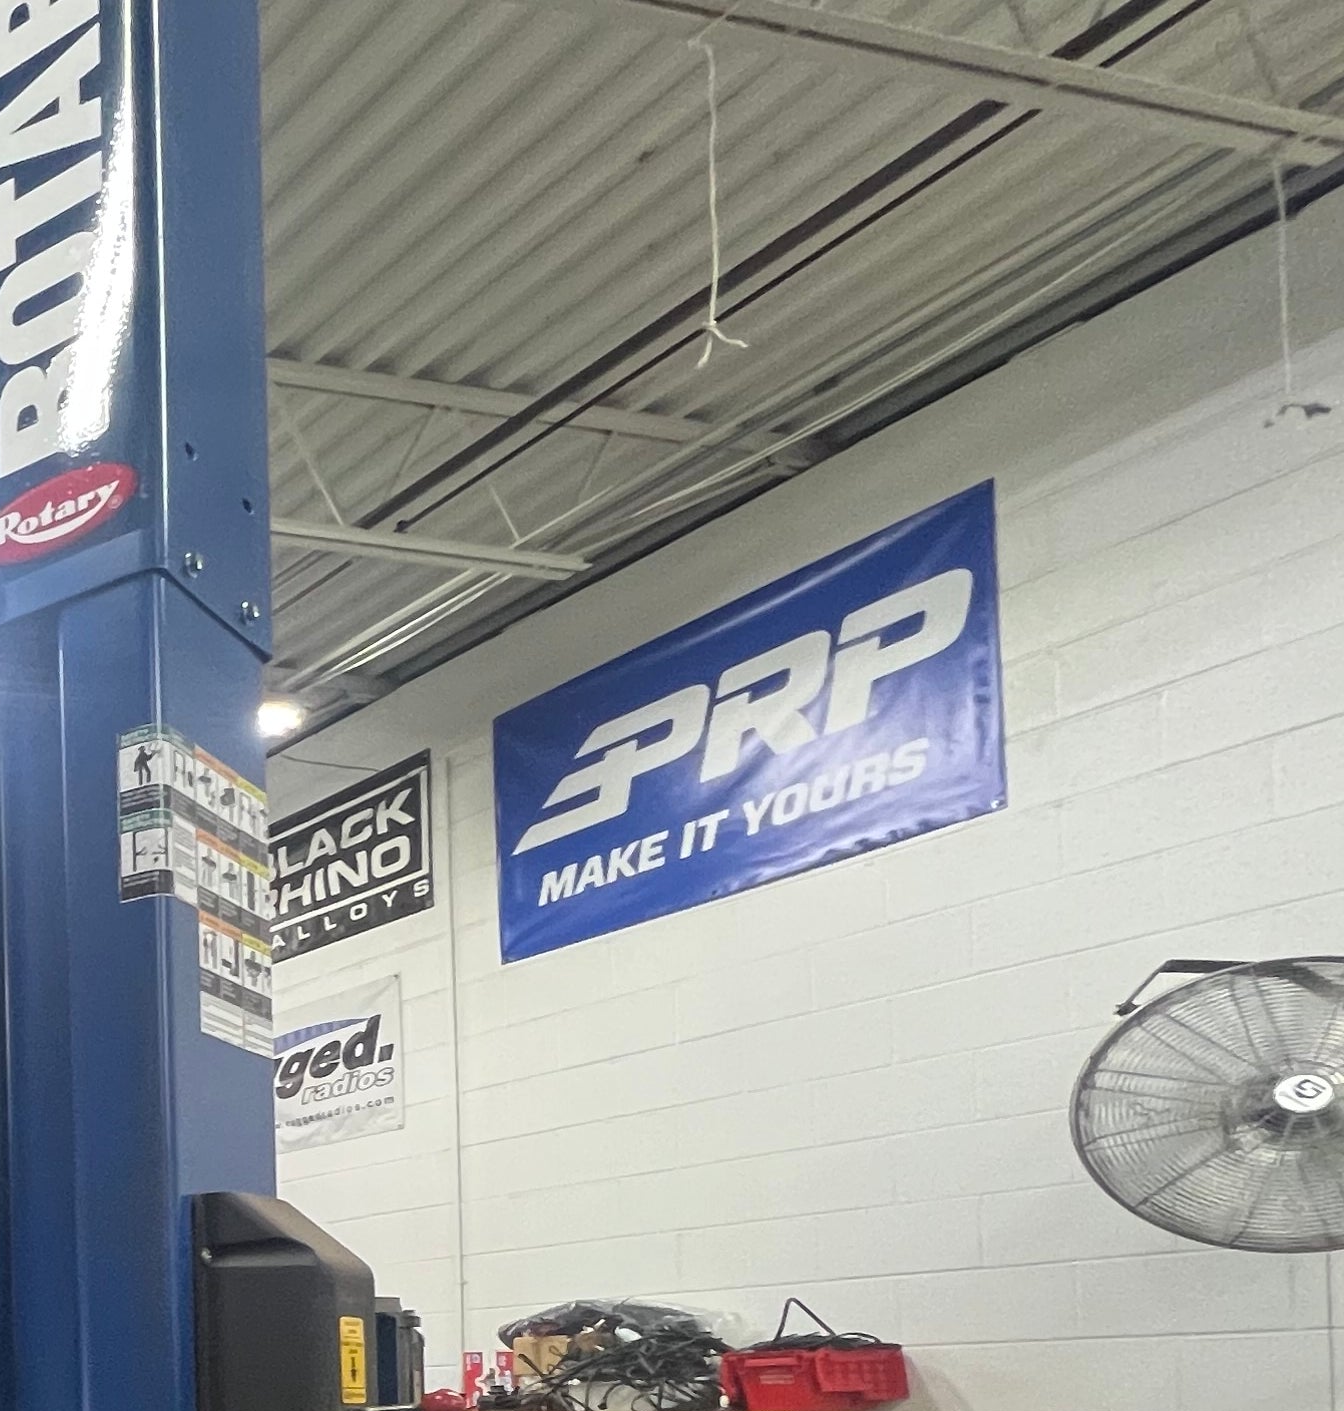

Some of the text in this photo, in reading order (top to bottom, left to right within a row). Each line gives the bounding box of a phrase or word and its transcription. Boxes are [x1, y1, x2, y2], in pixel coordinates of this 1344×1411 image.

[512, 568, 974, 856] PRP
[268, 788, 415, 882] LACK
[538, 737, 930, 907] MAKE IT YOURS
[271, 878, 430, 949] ALLOYS
[274, 1013, 394, 1099] ged.
[301, 1066, 395, 1105] radios
